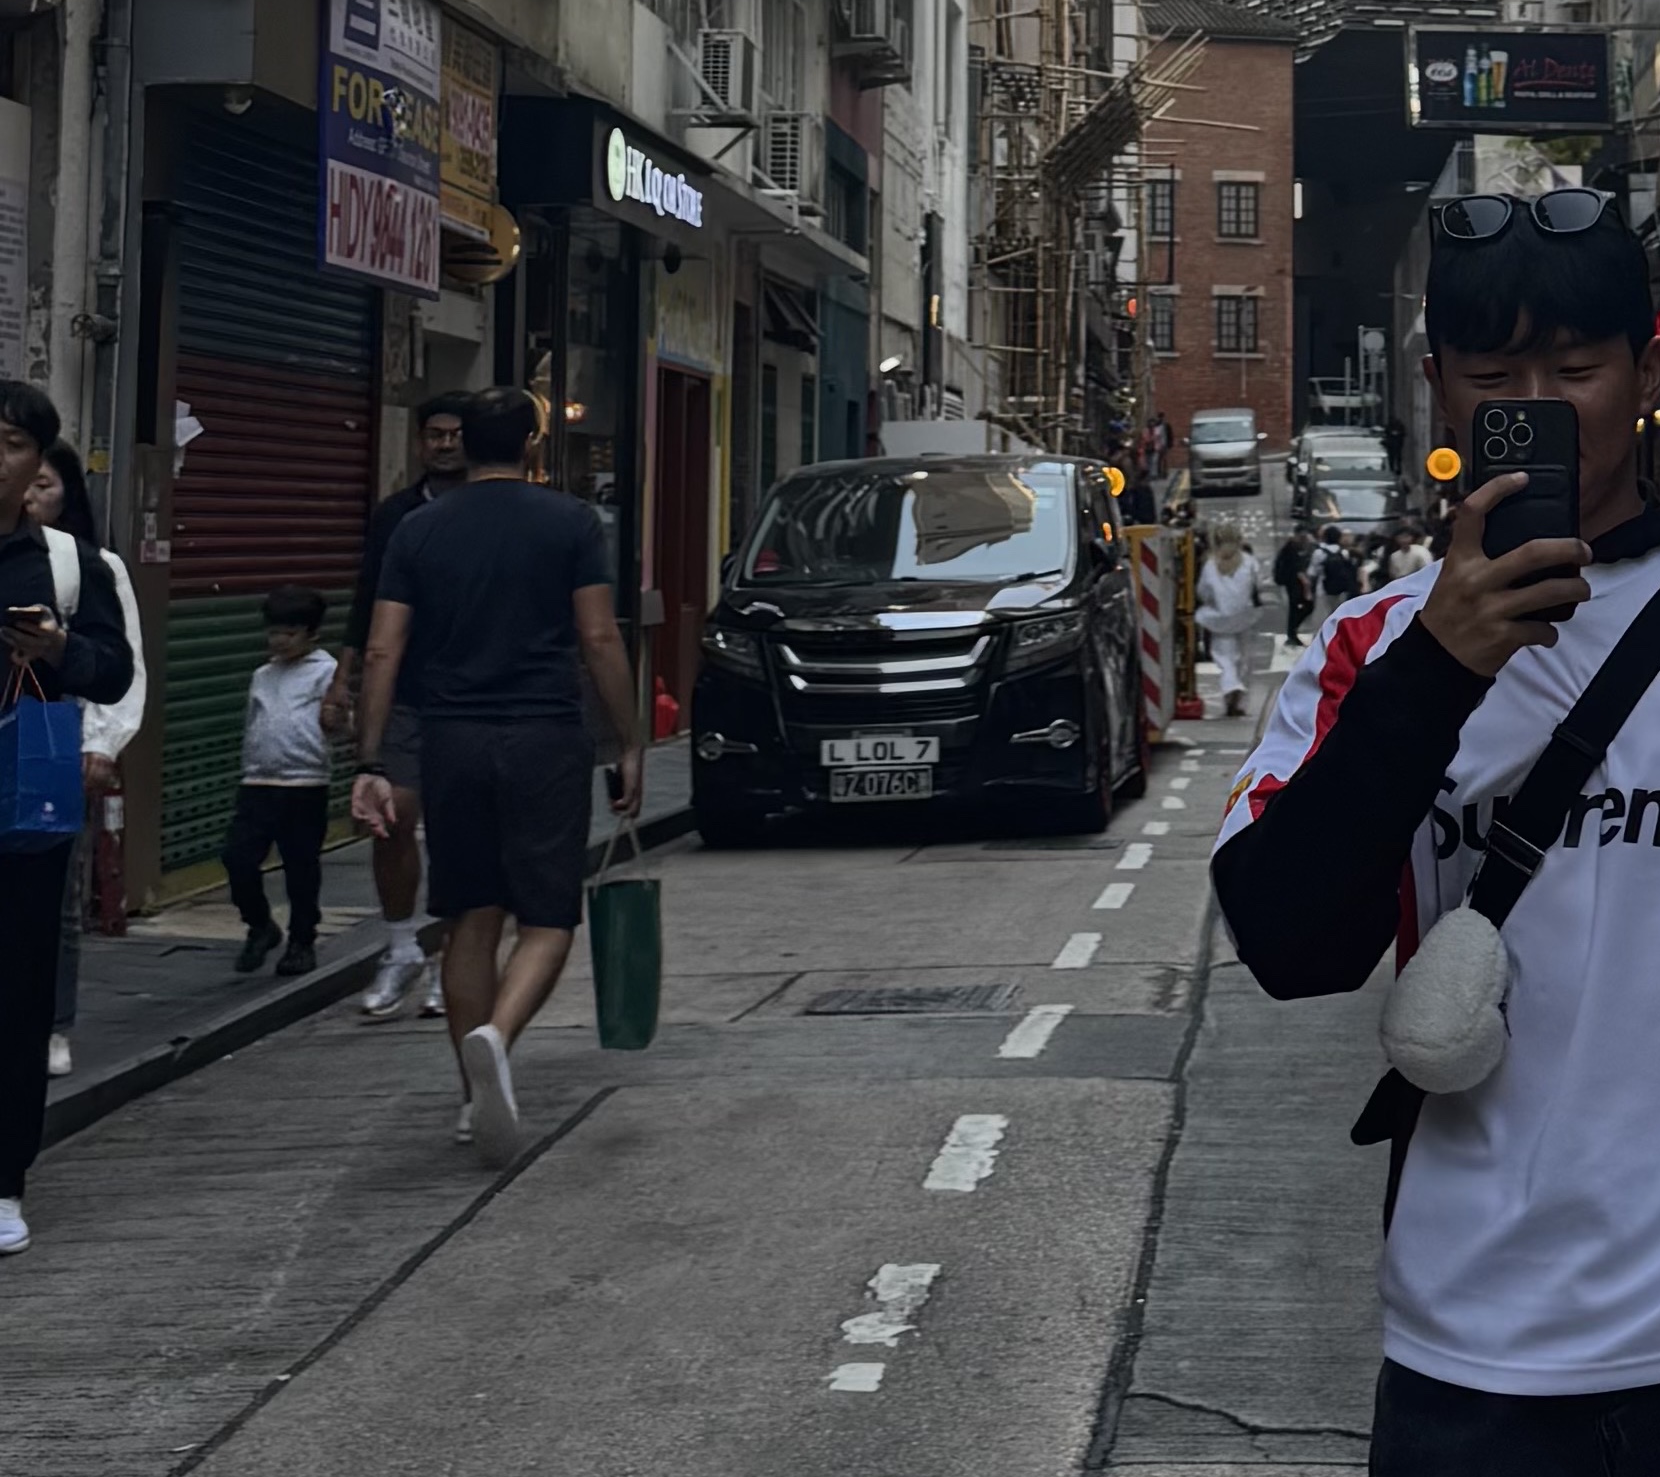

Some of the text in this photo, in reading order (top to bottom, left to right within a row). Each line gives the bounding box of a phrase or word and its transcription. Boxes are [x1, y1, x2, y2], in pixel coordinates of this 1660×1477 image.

[331, 64, 383, 128] FOR
[828, 739, 933, 763] L LOL 7
